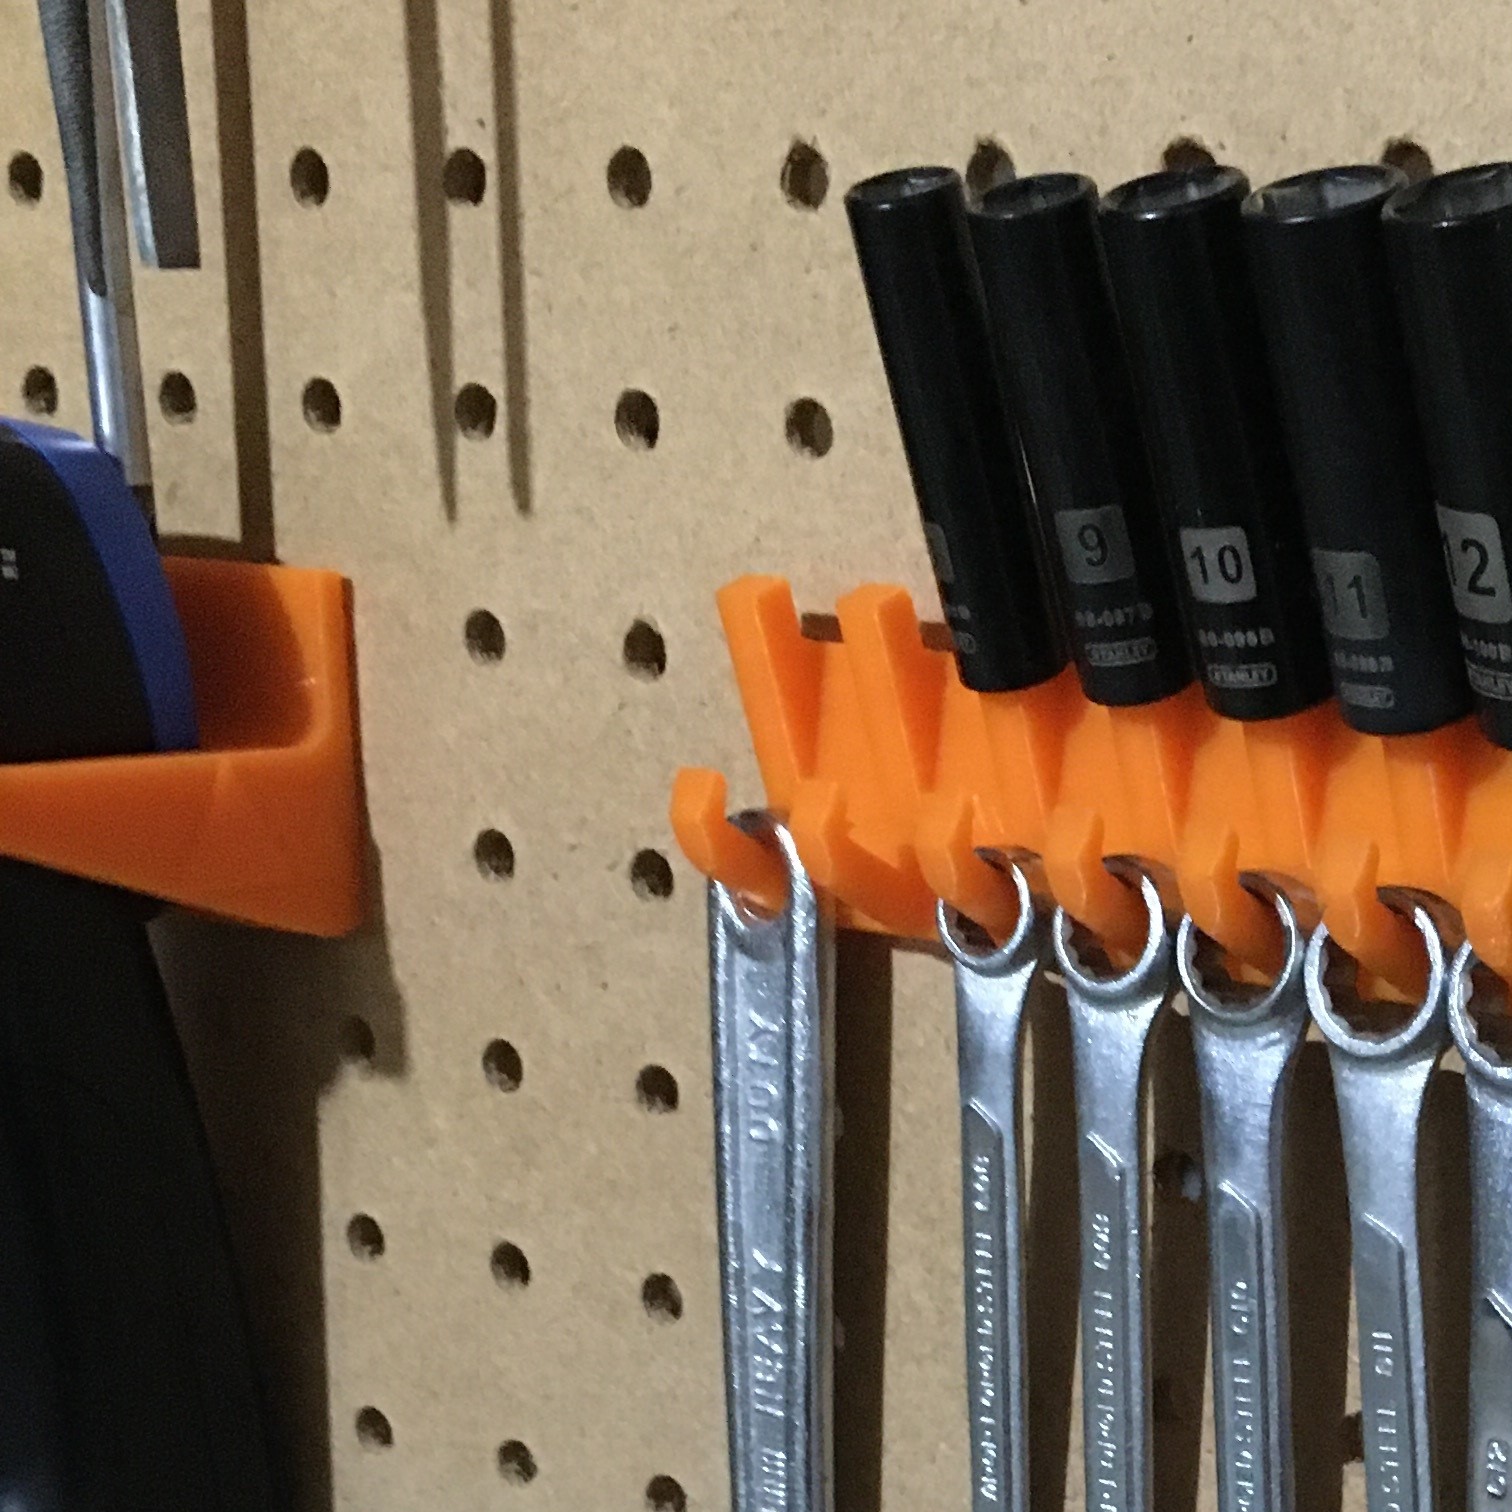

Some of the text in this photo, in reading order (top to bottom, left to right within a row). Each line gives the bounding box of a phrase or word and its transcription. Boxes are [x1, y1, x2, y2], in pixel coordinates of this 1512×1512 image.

[1076, 522, 1108, 568] 9
[1189, 543, 1243, 587] 10
[1323, 573, 1368, 620] 11
[746, 1009, 782, 1142] DUTY
[1376, 1404, 1399, 1494] STEEL
